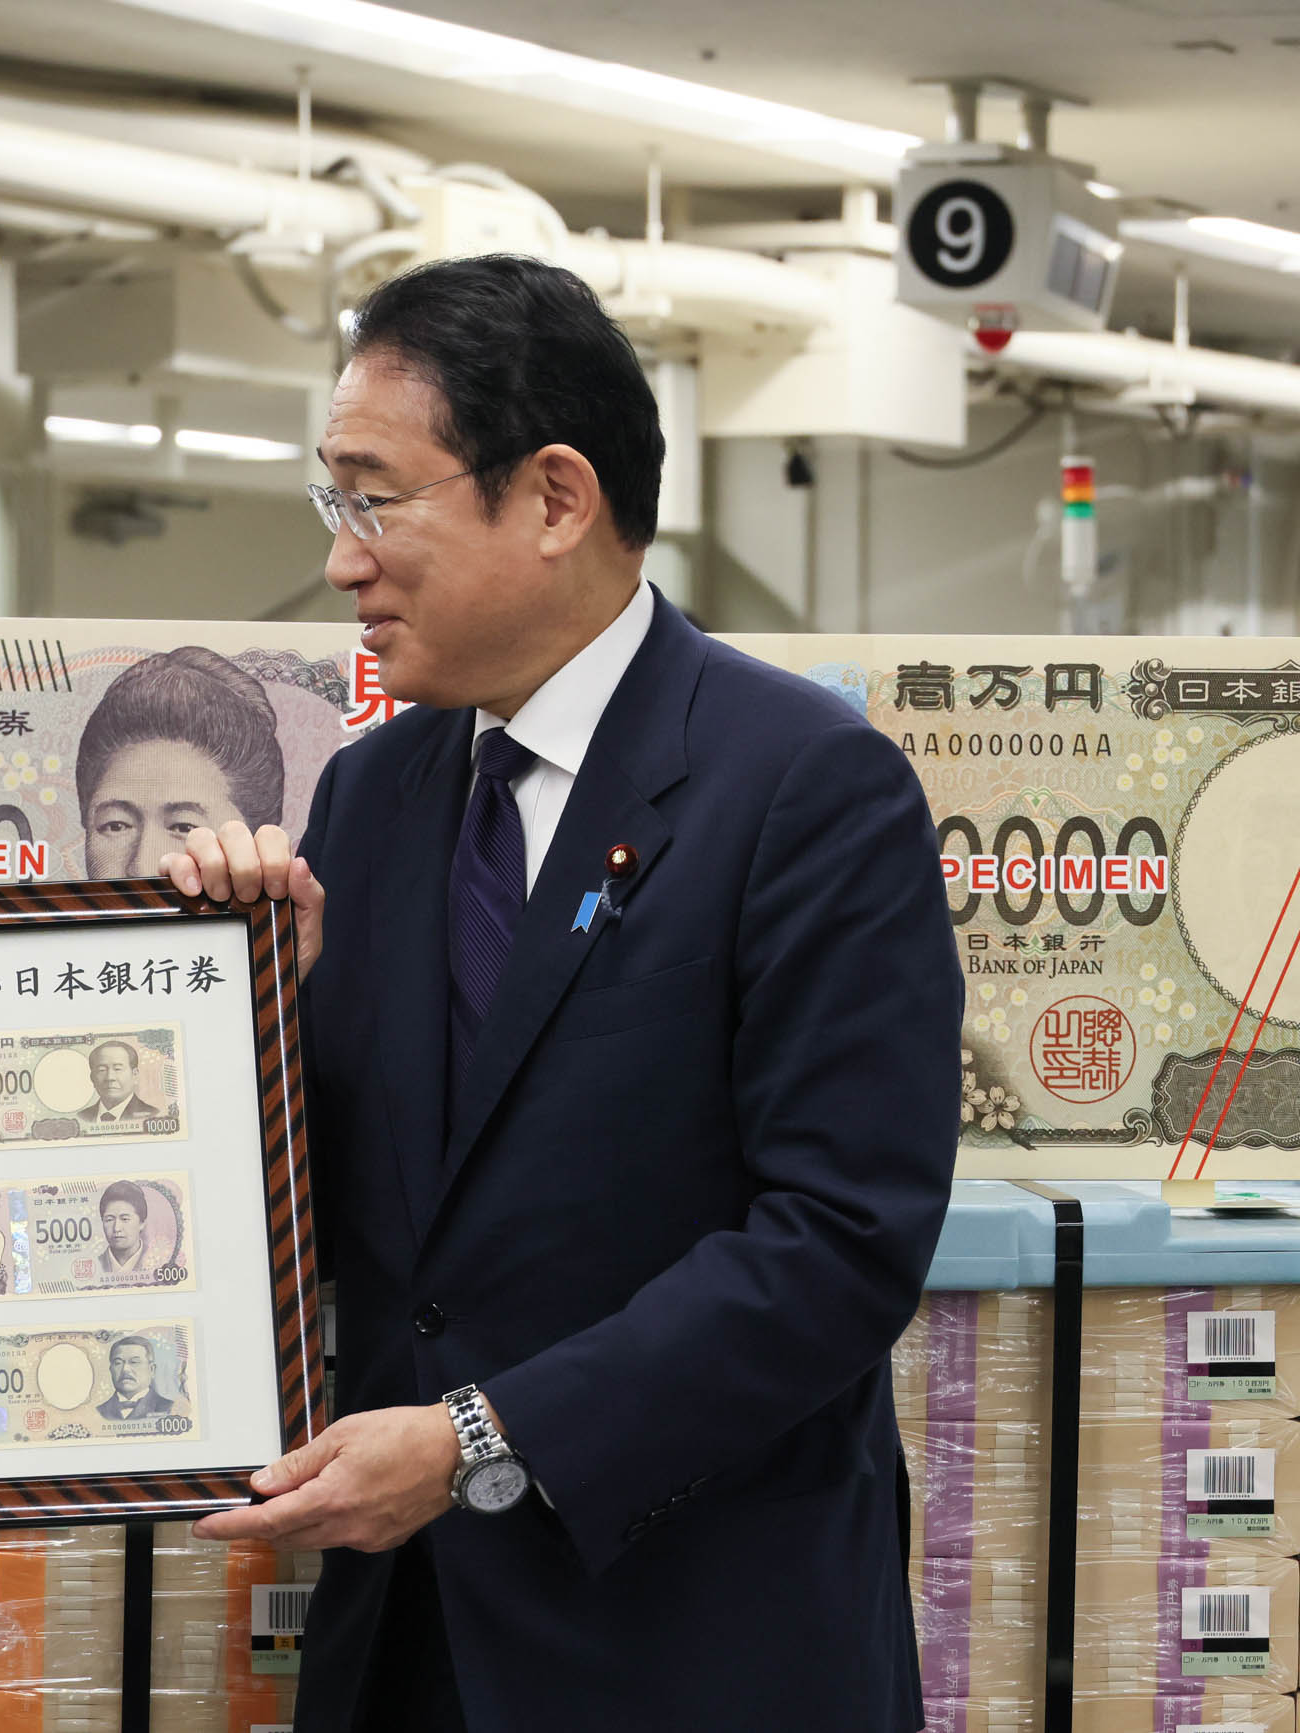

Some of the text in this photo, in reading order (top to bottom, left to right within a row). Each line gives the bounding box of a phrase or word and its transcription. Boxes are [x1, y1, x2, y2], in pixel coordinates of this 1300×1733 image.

[936, 197, 986, 271] 9
[895, 661, 1103, 712] 壱万円
[940, 858, 1165, 889] PECIMEN
[967, 933, 1106, 952] 日本銀行
[146, 1119, 176, 1132] 10000
[36, 1217, 92, 1244] 5000
[157, 1267, 186, 1281] 5000
[161, 1418, 187, 1432] 1000
